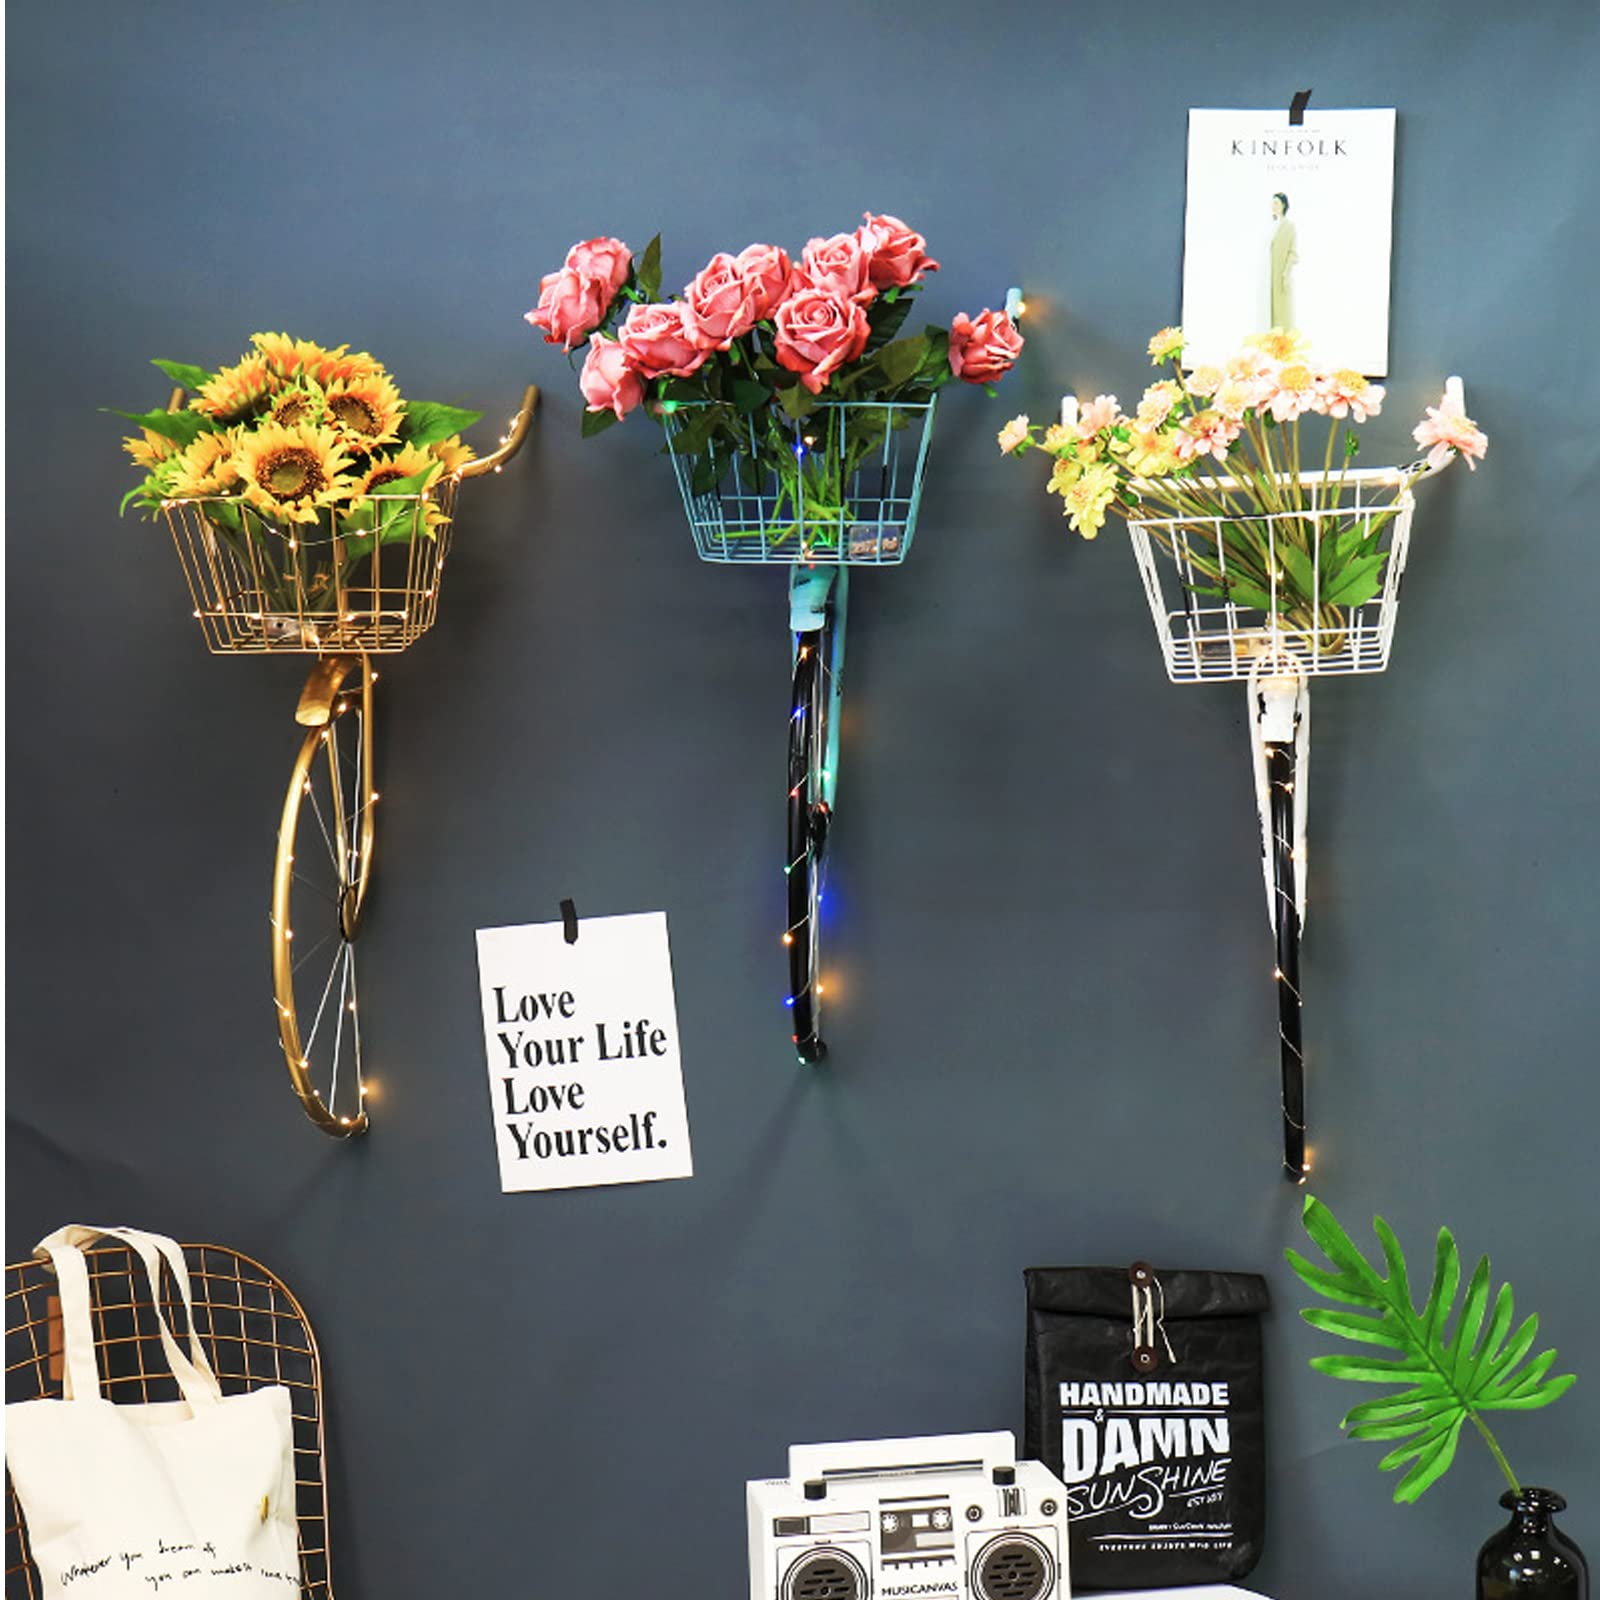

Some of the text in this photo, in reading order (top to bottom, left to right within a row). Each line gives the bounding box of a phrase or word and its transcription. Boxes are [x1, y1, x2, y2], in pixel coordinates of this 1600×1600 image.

[1231, 139, 1349, 156] KINFOLK
[491, 986, 576, 1025] Love
[497, 1019, 668, 1069] Your Life
[501, 1077, 585, 1115] Love
[506, 1111, 668, 1160] Yourself.
[1059, 1382, 1230, 1406] HANDMADE
[1062, 1418, 1230, 1484] DAMN
[881, 1581, 959, 1597] MUSICANVAS
